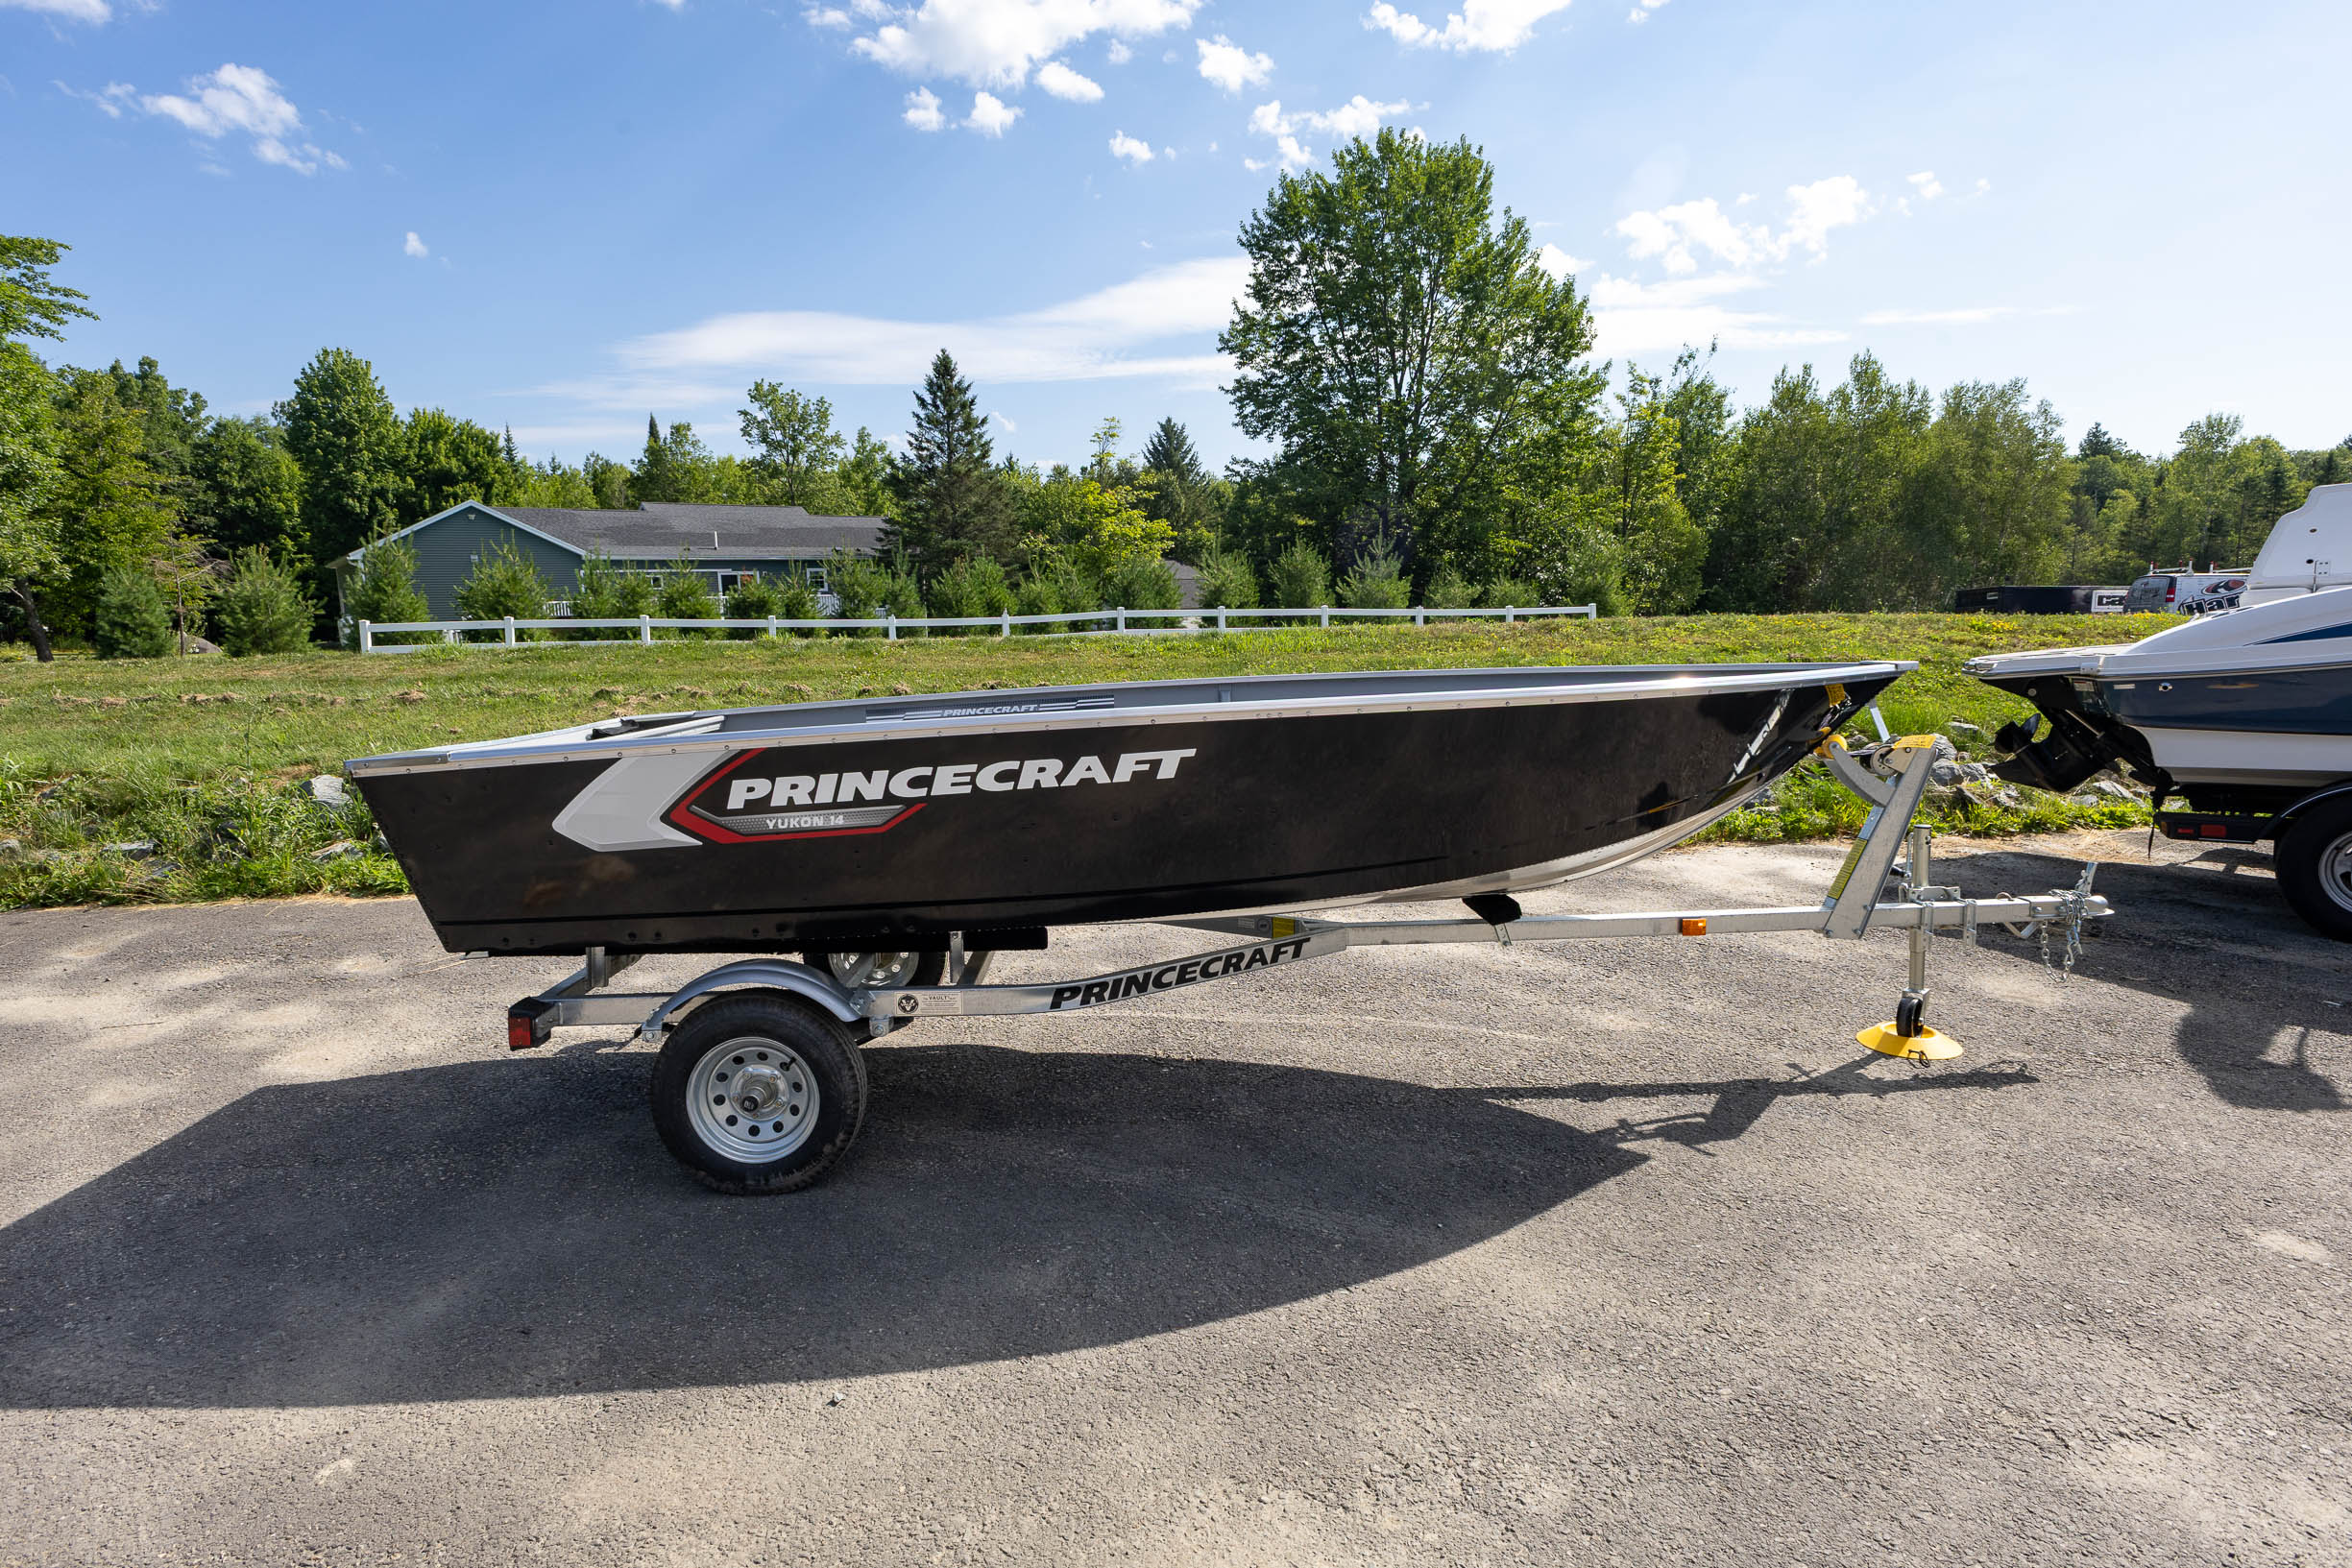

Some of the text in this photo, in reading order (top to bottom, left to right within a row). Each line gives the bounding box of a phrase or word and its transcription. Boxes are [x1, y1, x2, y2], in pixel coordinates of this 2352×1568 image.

[943, 704, 1037, 717] PRINCECRAFT
[727, 748, 1197, 809] PRINCECRAFT
[765, 814, 844, 830] YUKON 14
[1050, 937, 1311, 1009] PRINCECRAFT
